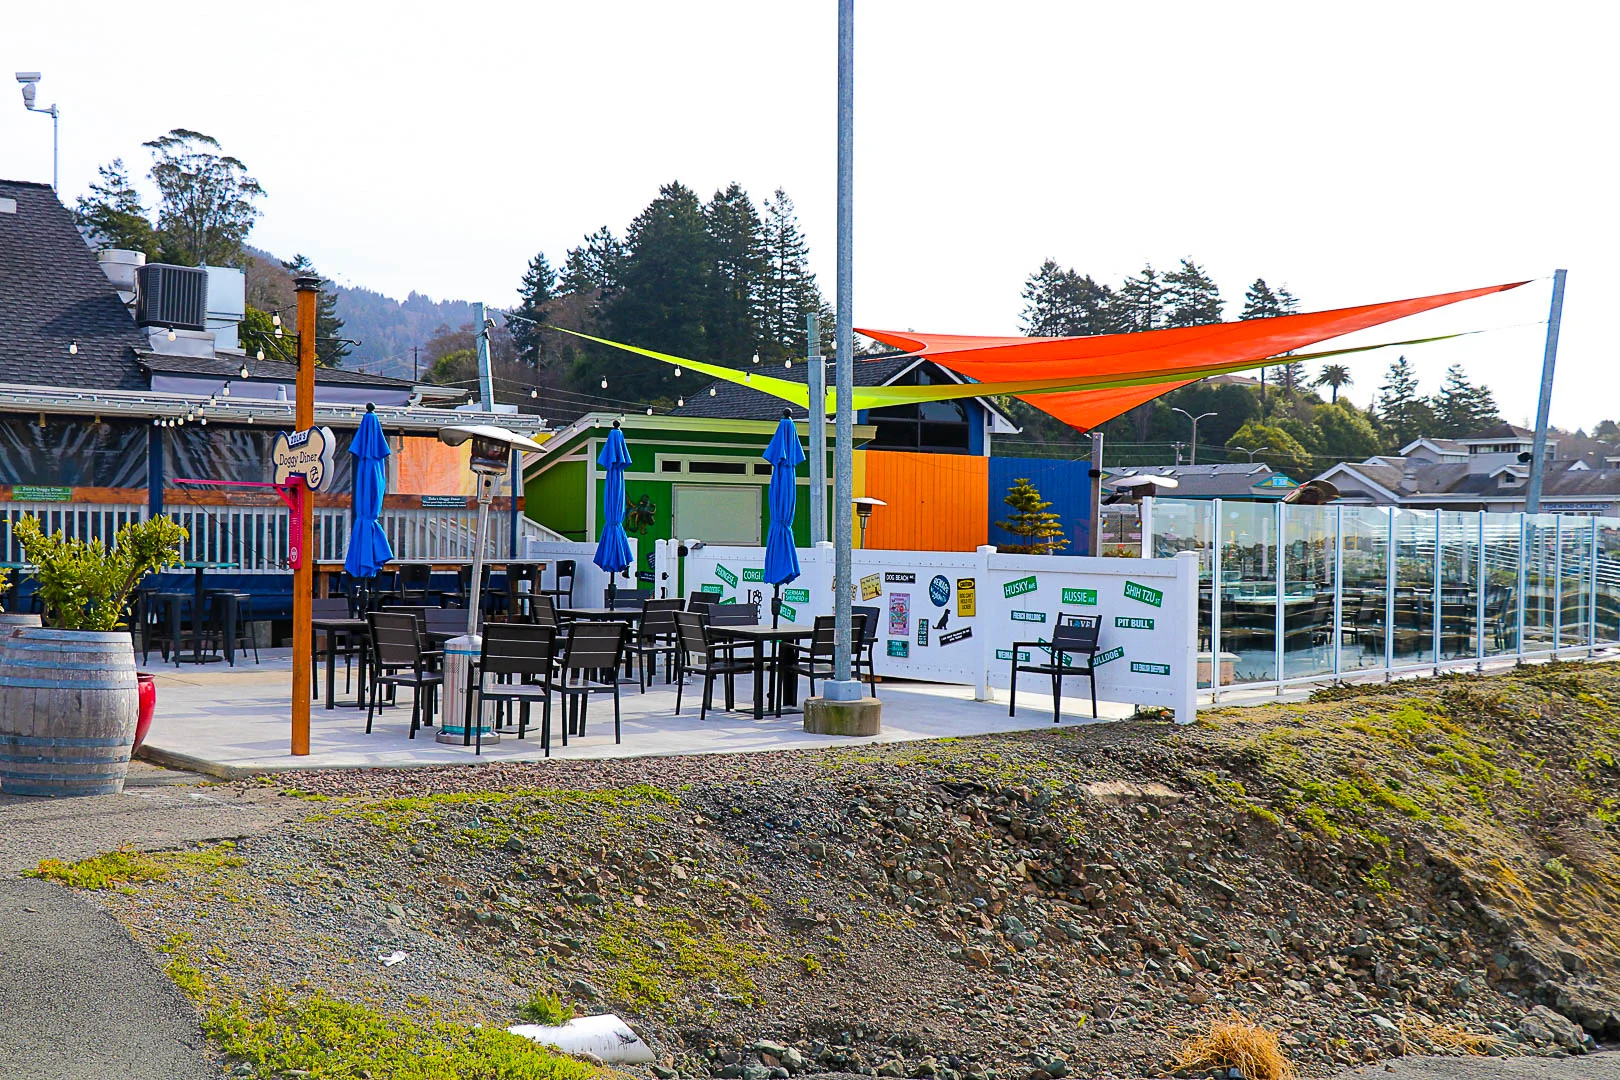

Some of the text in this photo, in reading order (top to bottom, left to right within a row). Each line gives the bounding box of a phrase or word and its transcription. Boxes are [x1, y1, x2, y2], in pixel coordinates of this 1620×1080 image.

[279, 451, 318, 469] Doggy Diner
[743, 570, 761, 580] CORGI
[895, 574, 909, 582] BEACH
[1005, 580, 1028, 596] HUSKY
[1125, 584, 1142, 599] SHIH
[1142, 589, 1156, 603] TZU
[1063, 591, 1087, 603] AUSSIE
[1117, 618, 1150, 629] PIT BULL
